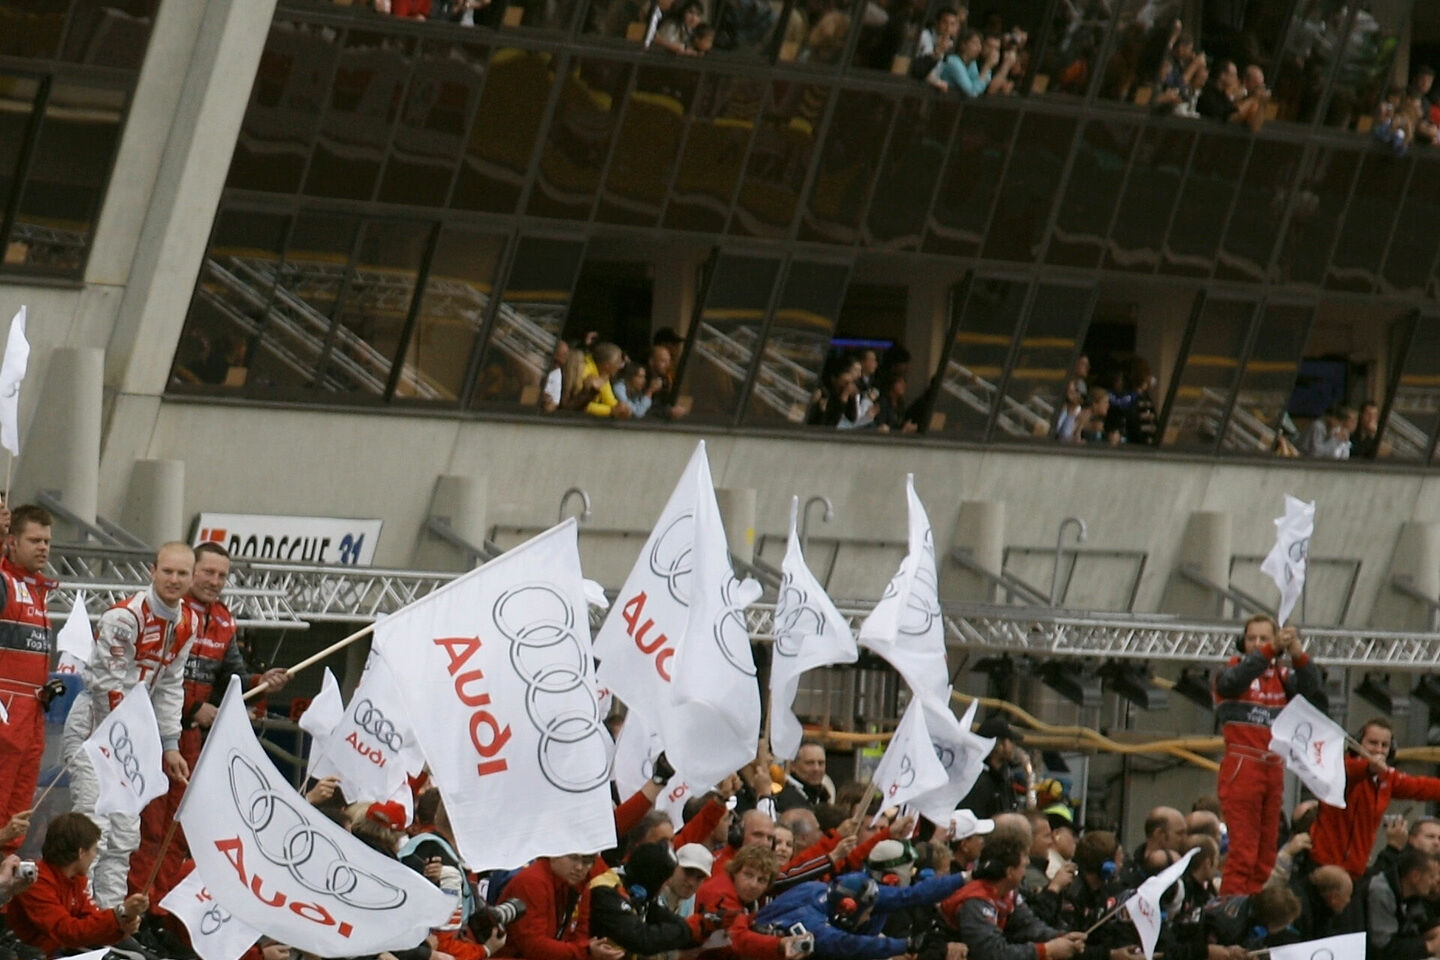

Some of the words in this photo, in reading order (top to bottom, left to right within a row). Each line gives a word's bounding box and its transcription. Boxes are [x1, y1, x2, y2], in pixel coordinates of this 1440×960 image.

[345, 731, 387, 769] Audi
[433, 636, 512, 777] Audi
[215, 834, 354, 938] Audi
